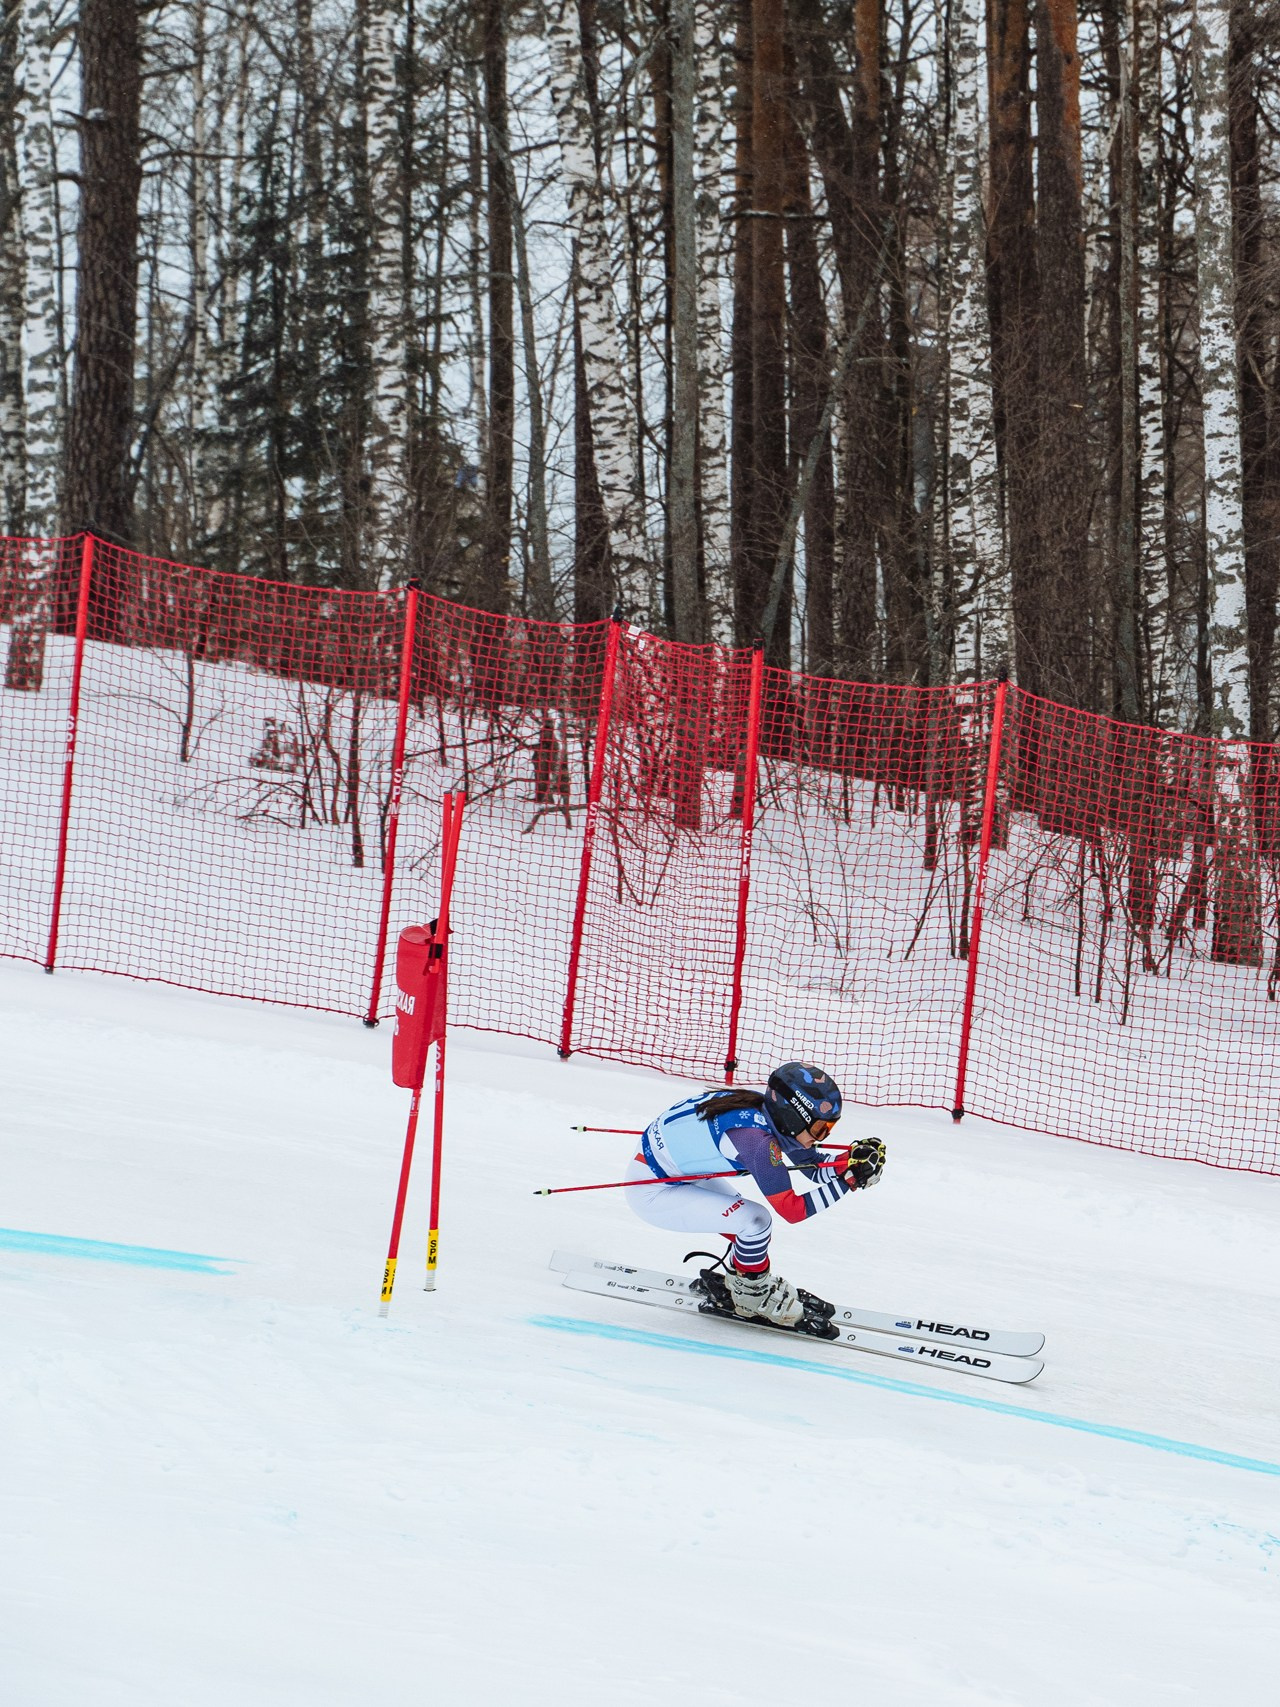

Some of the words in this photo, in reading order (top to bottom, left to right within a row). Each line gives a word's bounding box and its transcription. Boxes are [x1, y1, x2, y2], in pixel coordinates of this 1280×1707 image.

[428, 1239, 437, 1264] SPM
[916, 1320, 991, 1341] HEAD
[918, 1346, 992, 1369] HEAD
